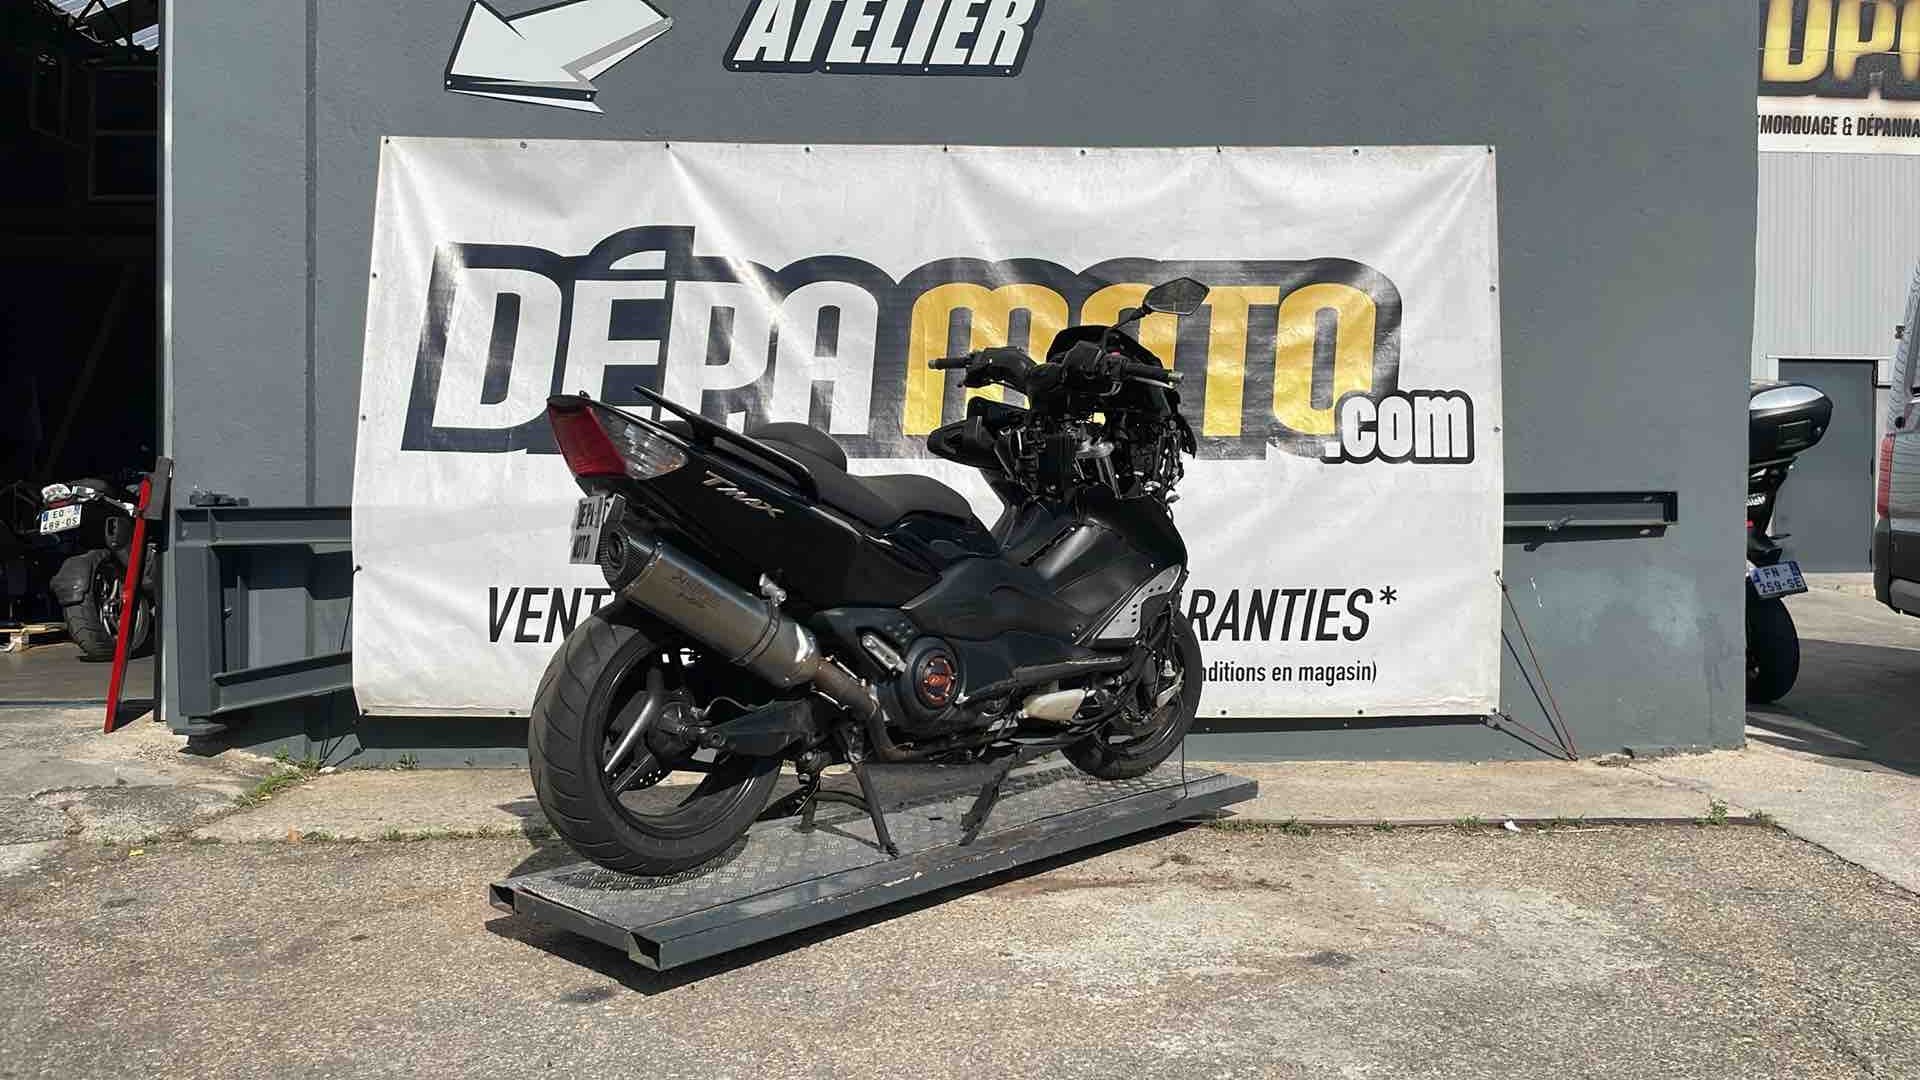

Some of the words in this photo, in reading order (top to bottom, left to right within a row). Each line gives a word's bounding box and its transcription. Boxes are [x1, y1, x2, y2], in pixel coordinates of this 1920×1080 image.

[732, 0, 1036, 66] ATELIER
[1759, 114, 1838, 136] MORQUAGE
[1842, 116, 1852, 136] &
[703, 470, 785, 519] TMAX
[488, 587, 612, 643] VENT
[1272, 666, 1292, 682] en
[1299, 661, 1377, 687] magasin)
